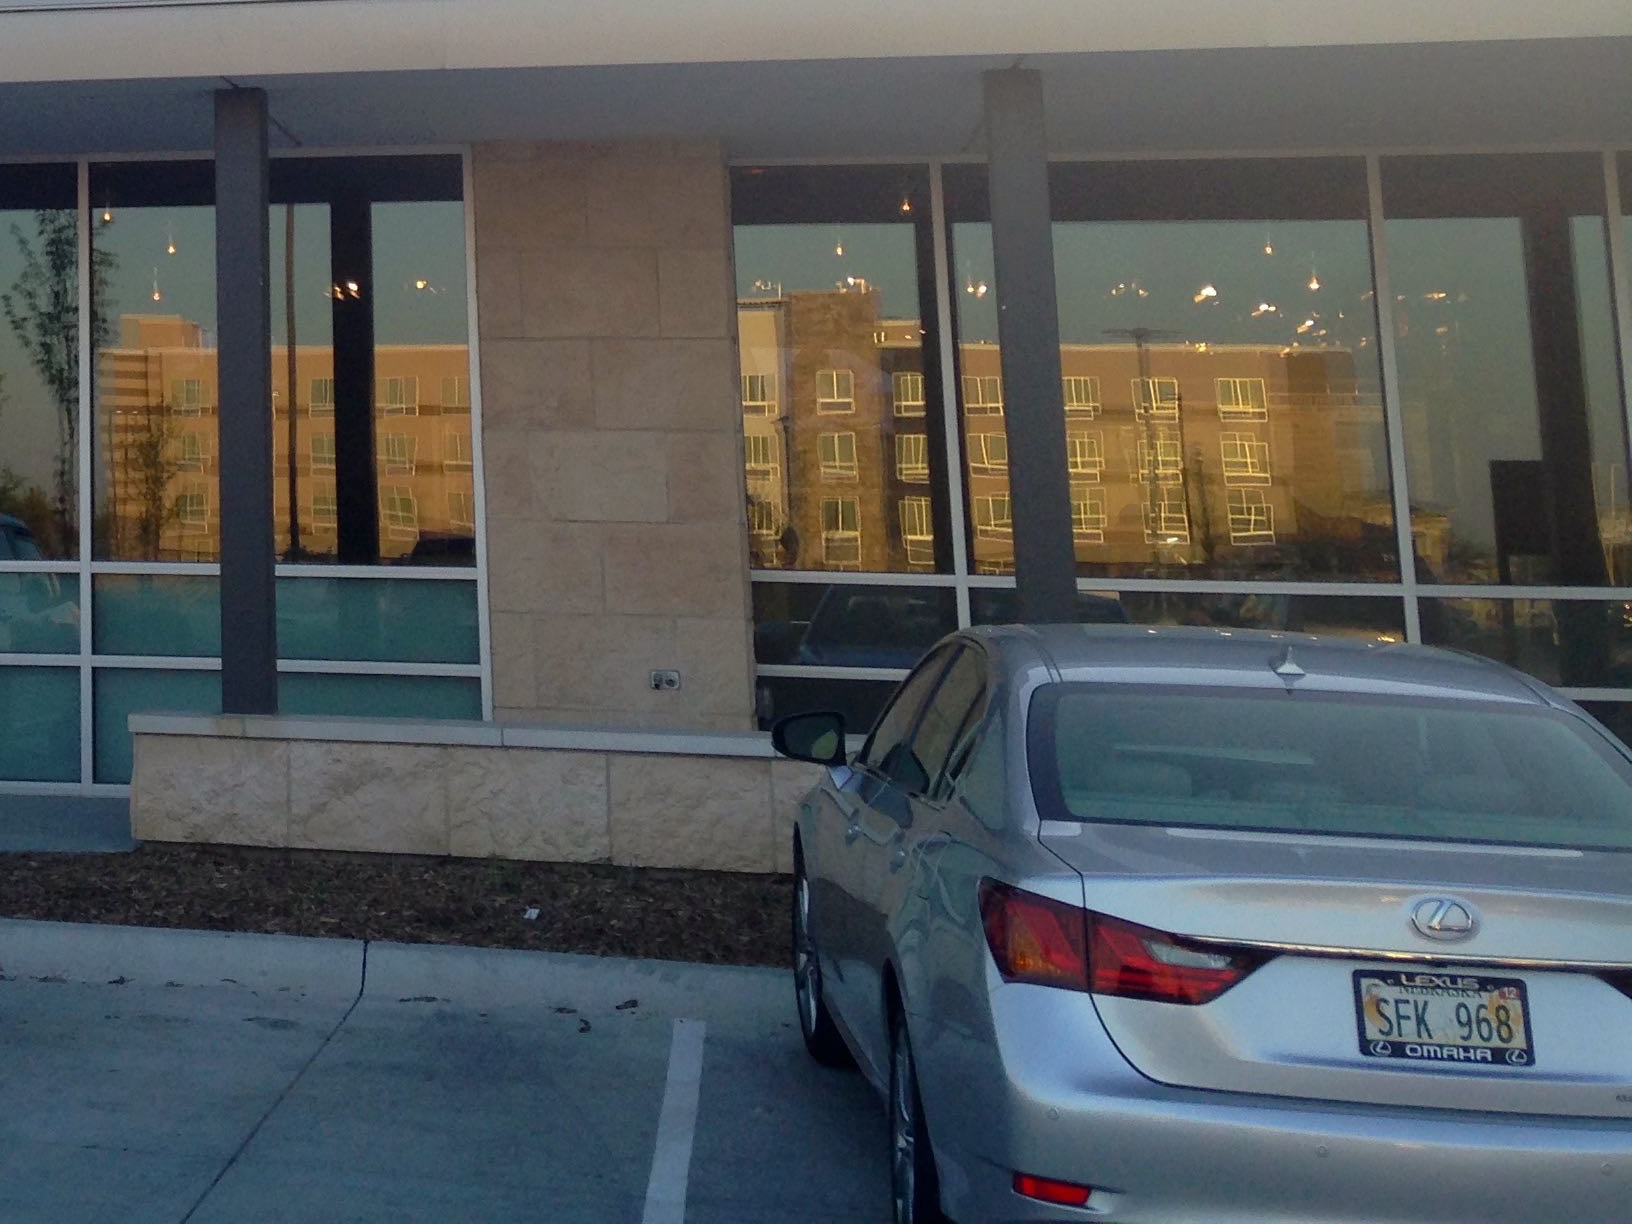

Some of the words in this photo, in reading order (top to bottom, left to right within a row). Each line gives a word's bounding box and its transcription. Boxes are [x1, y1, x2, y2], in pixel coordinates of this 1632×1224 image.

[1401, 973, 1480, 989] LEXUS
[1376, 997, 1434, 1040] SFK
[1455, 1002, 1514, 1044] 968
[1405, 1044, 1493, 1062] OMAHA
